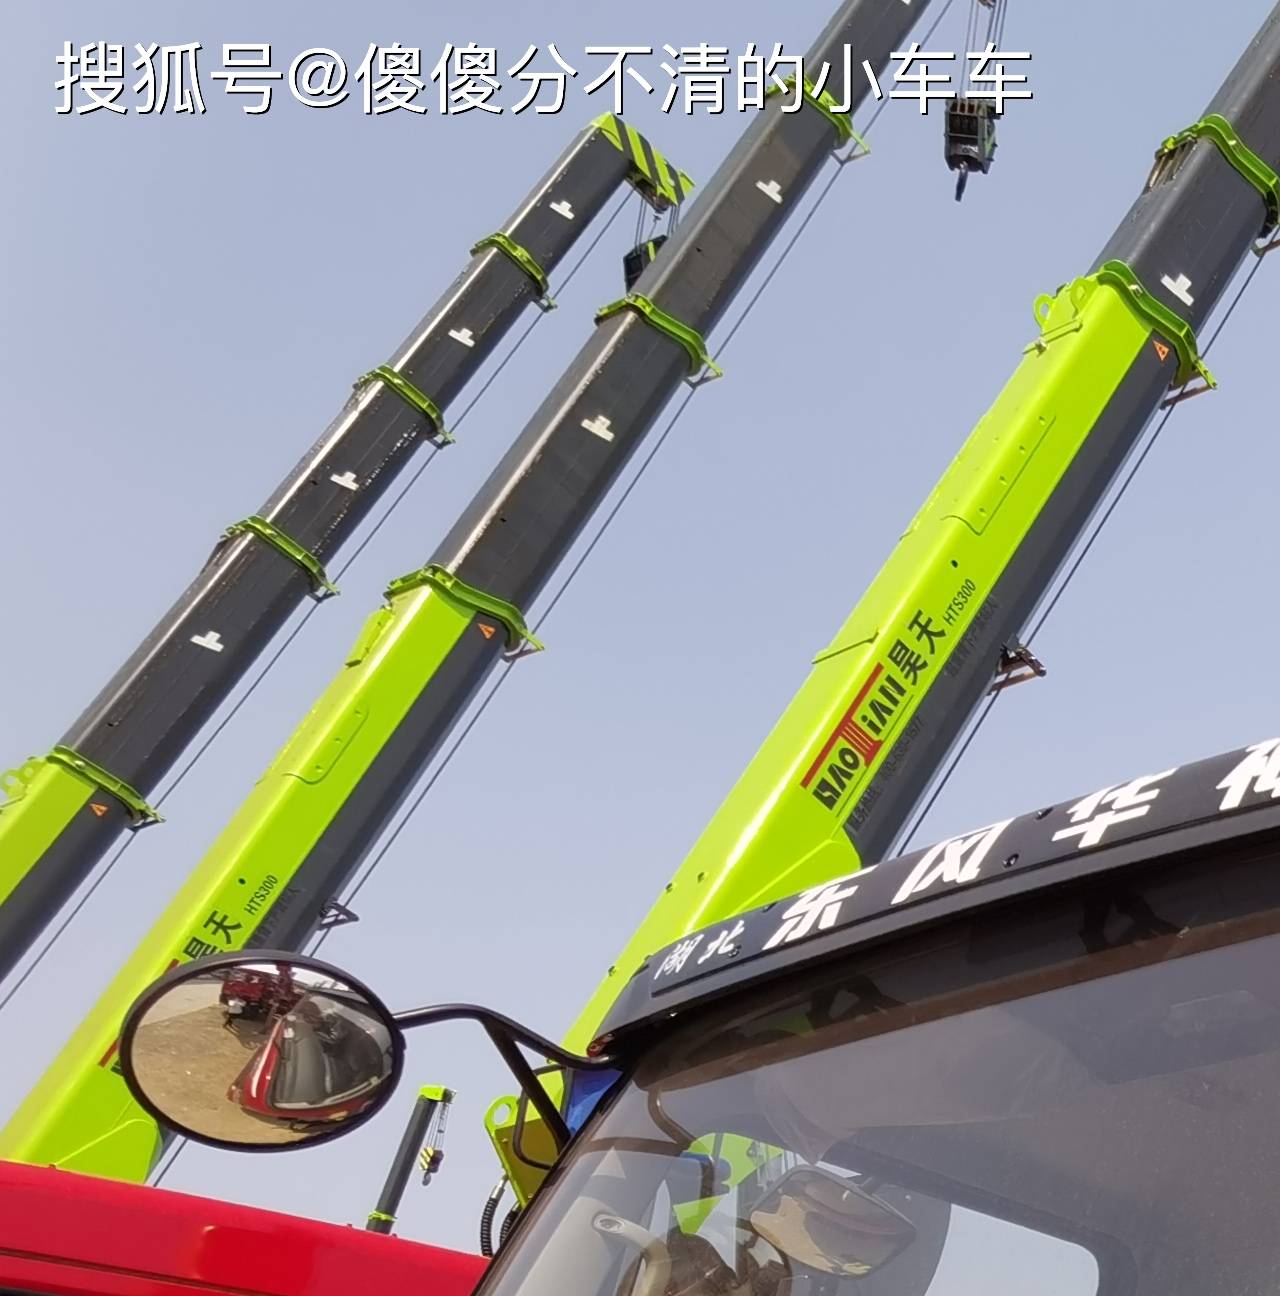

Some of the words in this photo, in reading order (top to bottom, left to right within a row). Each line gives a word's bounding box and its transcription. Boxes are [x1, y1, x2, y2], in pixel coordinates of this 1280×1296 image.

[887, 608, 946, 686] 昊天
[943, 578, 977, 626] HTS300
[243, 874, 279, 915] HTS300
